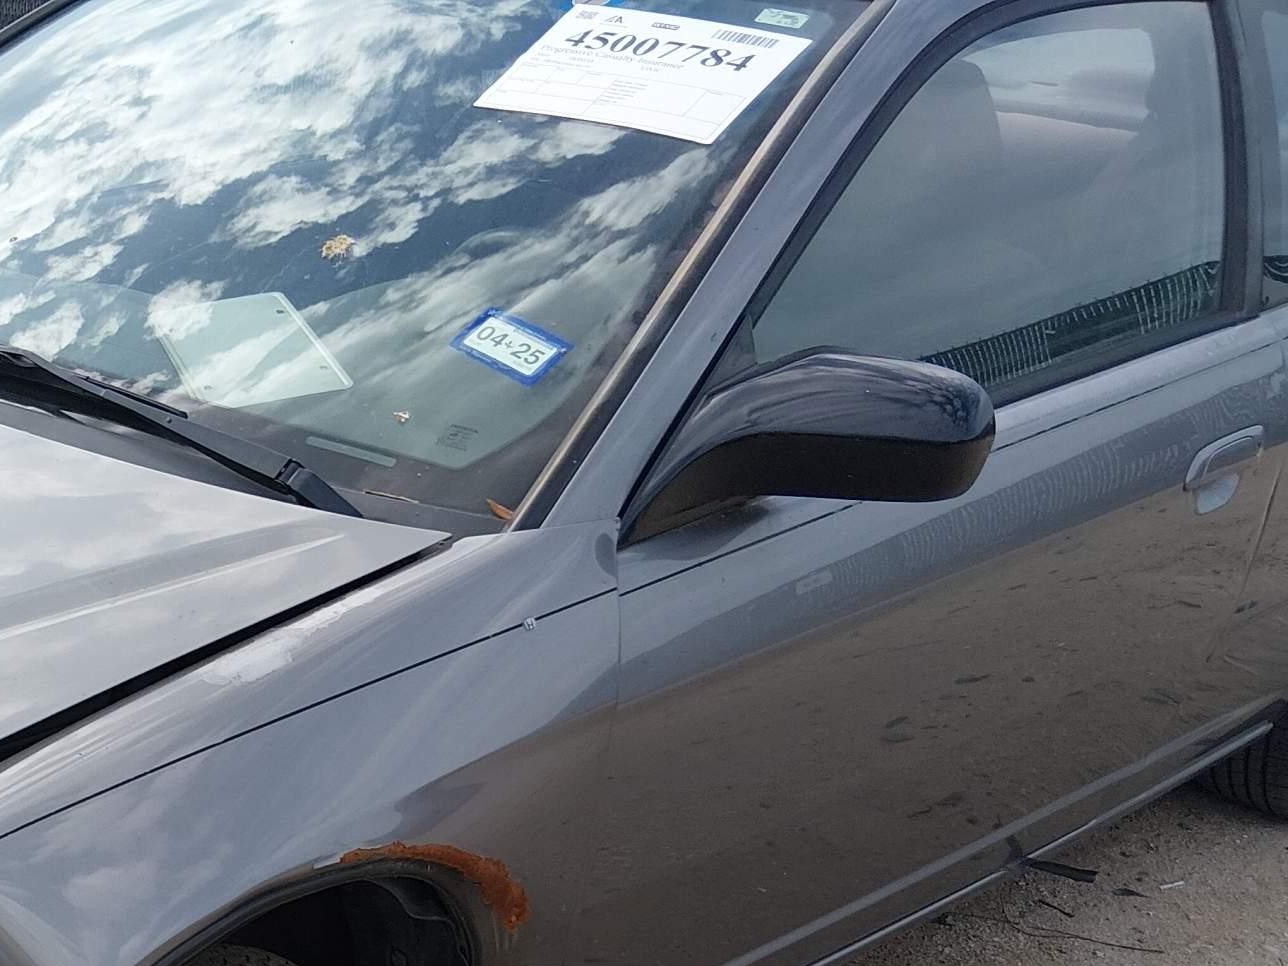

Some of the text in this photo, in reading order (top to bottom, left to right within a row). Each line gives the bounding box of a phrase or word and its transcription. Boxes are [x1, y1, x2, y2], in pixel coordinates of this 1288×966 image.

[564, 28, 757, 72] 45007784
[476, 326, 546, 365] 04 25
